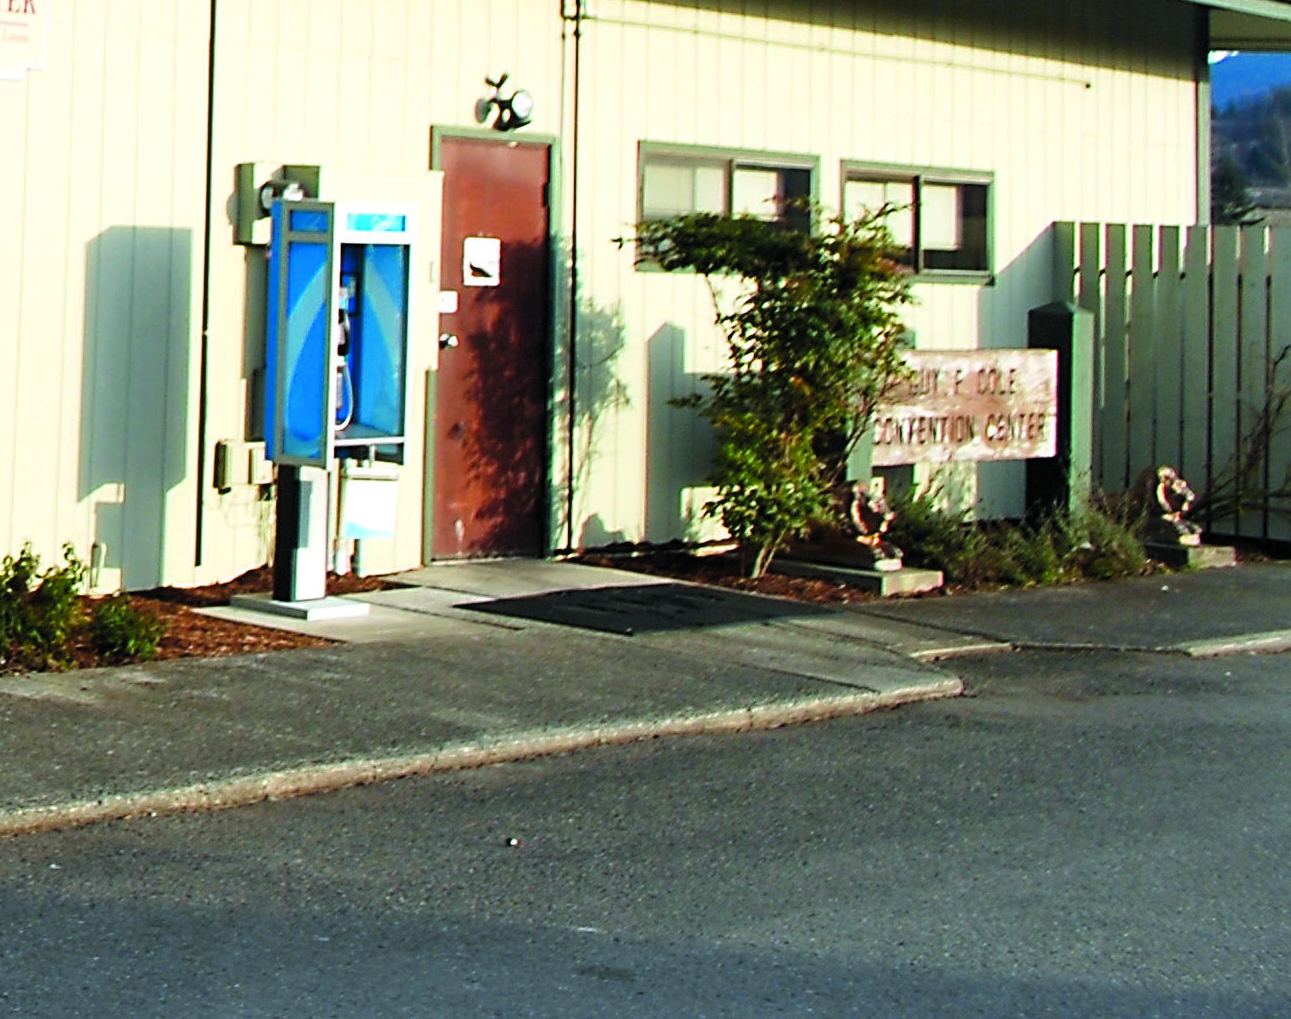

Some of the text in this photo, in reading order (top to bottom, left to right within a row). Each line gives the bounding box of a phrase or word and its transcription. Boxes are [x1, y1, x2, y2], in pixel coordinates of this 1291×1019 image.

[977, 367, 1017, 396] COLE
[871, 412, 1048, 446] CONVENTION CENTER
